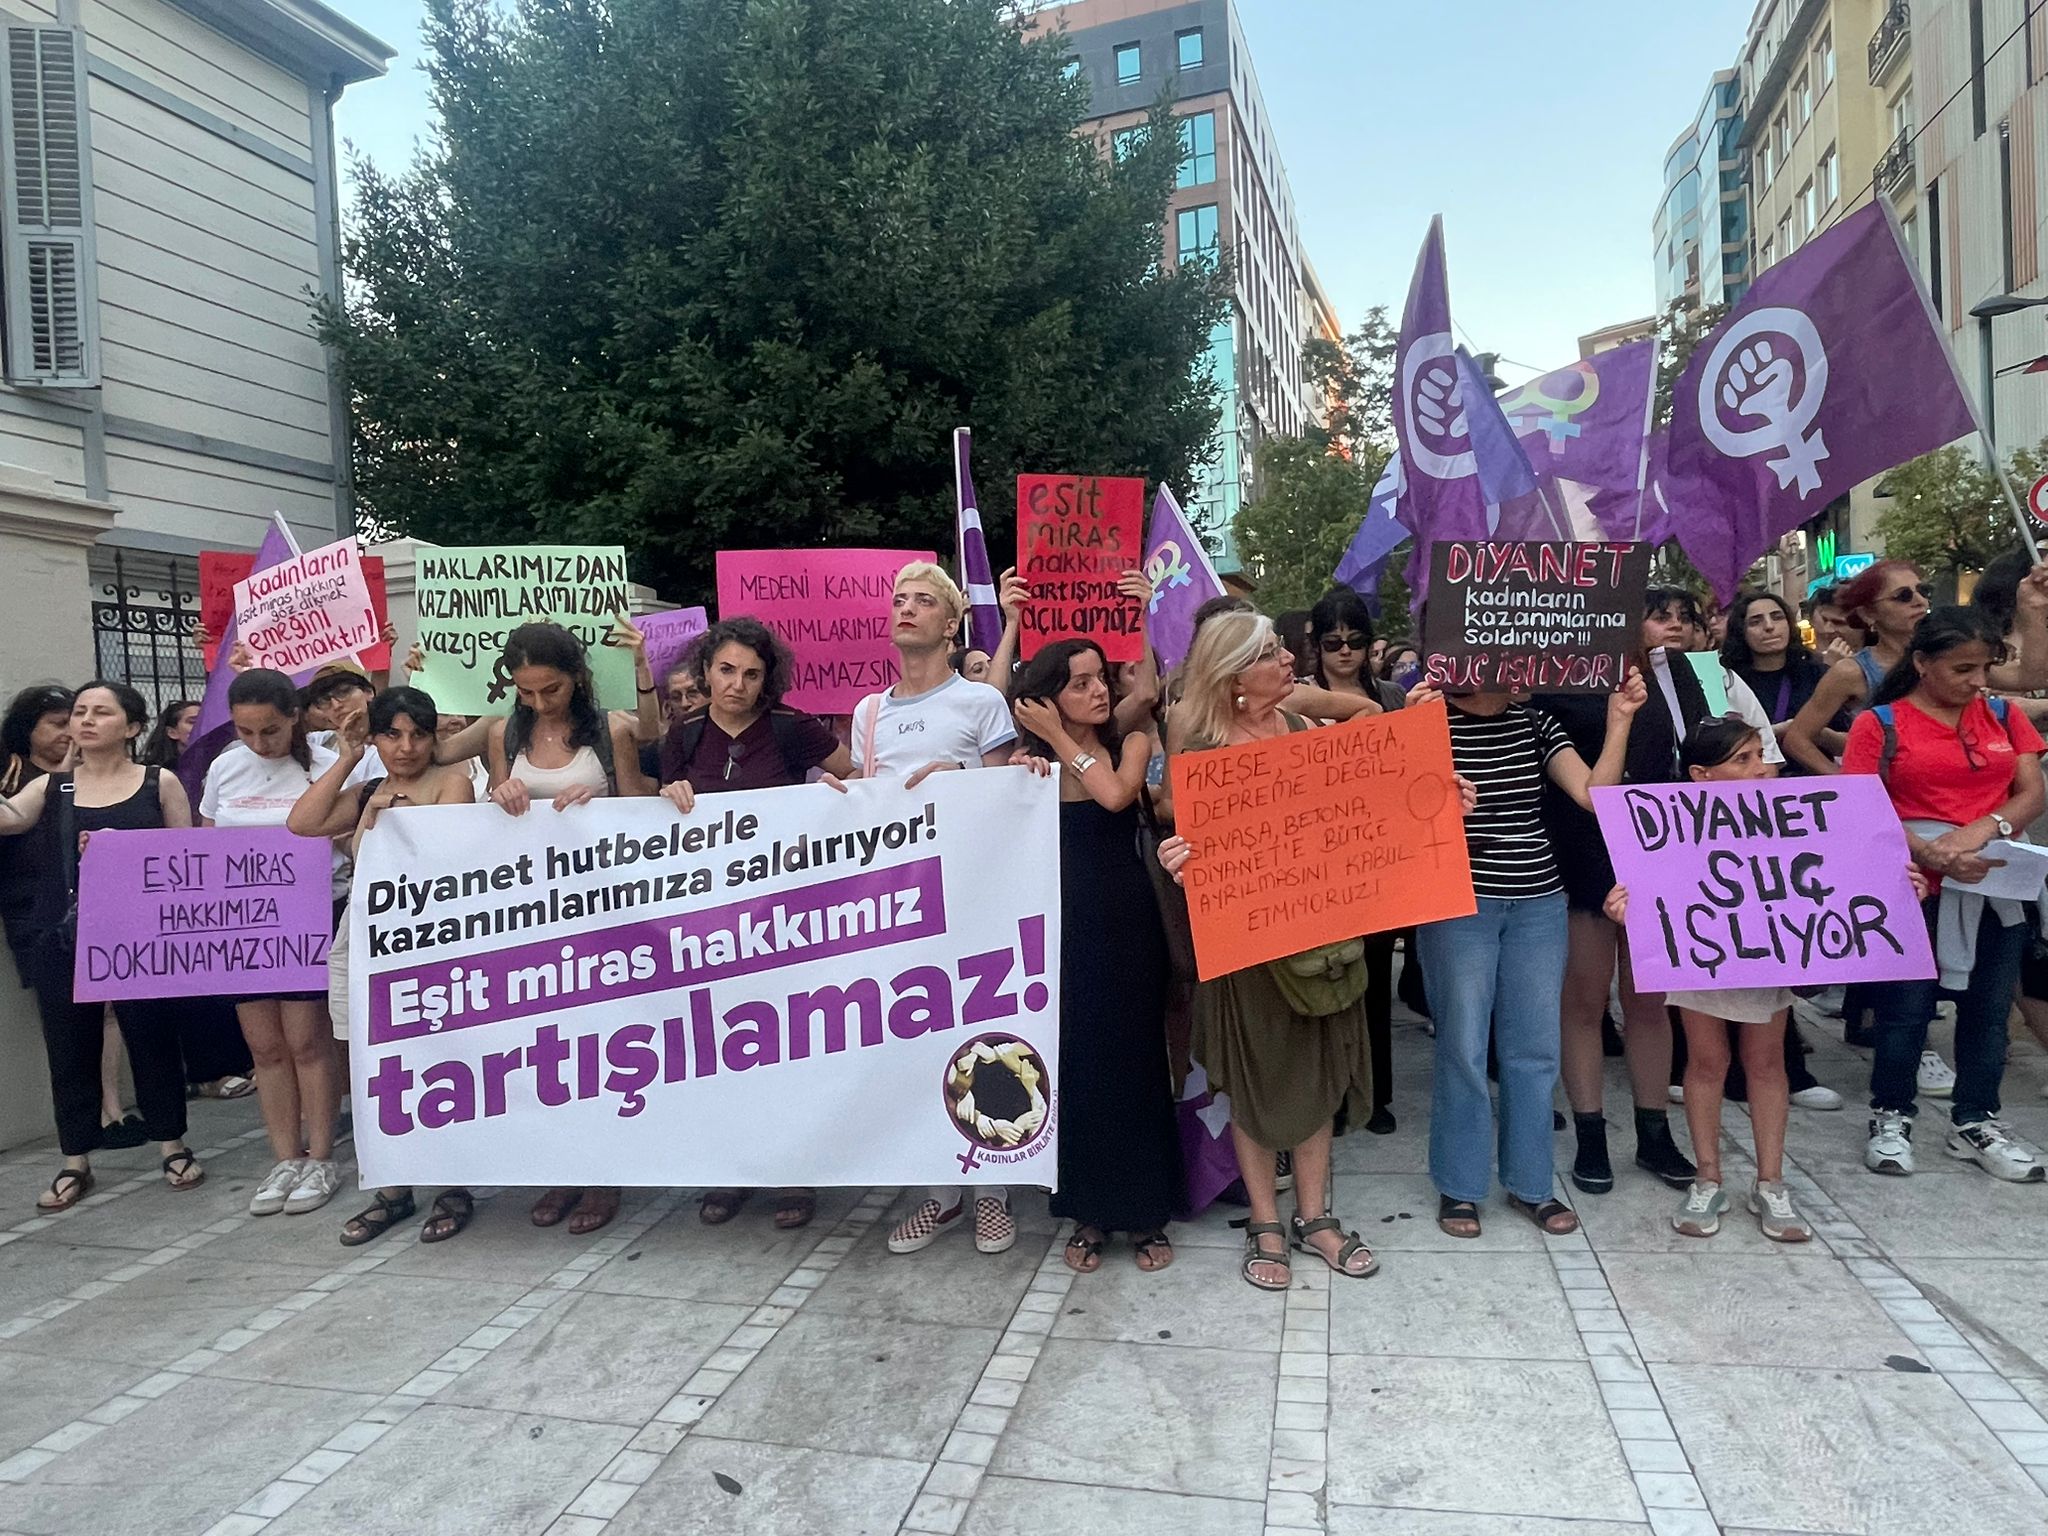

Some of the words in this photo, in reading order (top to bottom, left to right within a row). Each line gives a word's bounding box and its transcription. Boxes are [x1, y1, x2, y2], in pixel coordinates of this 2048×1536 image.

[248, 547, 350, 604] kadınların
[294, 575, 346, 600] hakkına
[423, 554, 625, 585] HAKLARIMIZDAN
[740, 568, 809, 601] MEDENİ
[1446, 541, 1635, 589] DİYANET
[271, 604, 298, 623] göz
[418, 583, 630, 619] KAZANIMLARIMIZDAN
[1464, 608, 1626, 628] kazanımlarına
[1465, 585, 1585, 609] kadınların
[1190, 775, 1308, 829] DEPREME
[1624, 789, 1838, 851] DİYANET
[143, 848, 210, 892] EŞİT
[225, 847, 297, 886] MİRAS
[367, 853, 533, 916] Diyanet
[546, 809, 759, 880] hutbelerle
[368, 867, 713, 958] kazanımlarımıza
[725, 802, 936, 887] saldırıyor!
[1199, 862, 1328, 913] AYRILMASINI
[1346, 843, 1415, 876] KABUL
[1698, 850, 1835, 906] SUÇ
[159, 897, 279, 931] HAKKIMIZA
[87, 933, 329, 982] DOKUNAMAZSINIZ
[389, 967, 492, 1032] Eşit
[507, 944, 657, 1004] miras
[671, 885, 923, 974] hakkımız
[368, 914, 1050, 1137] tartışılamaz!
[977, 1151, 1028, 1164] KADINLAR
